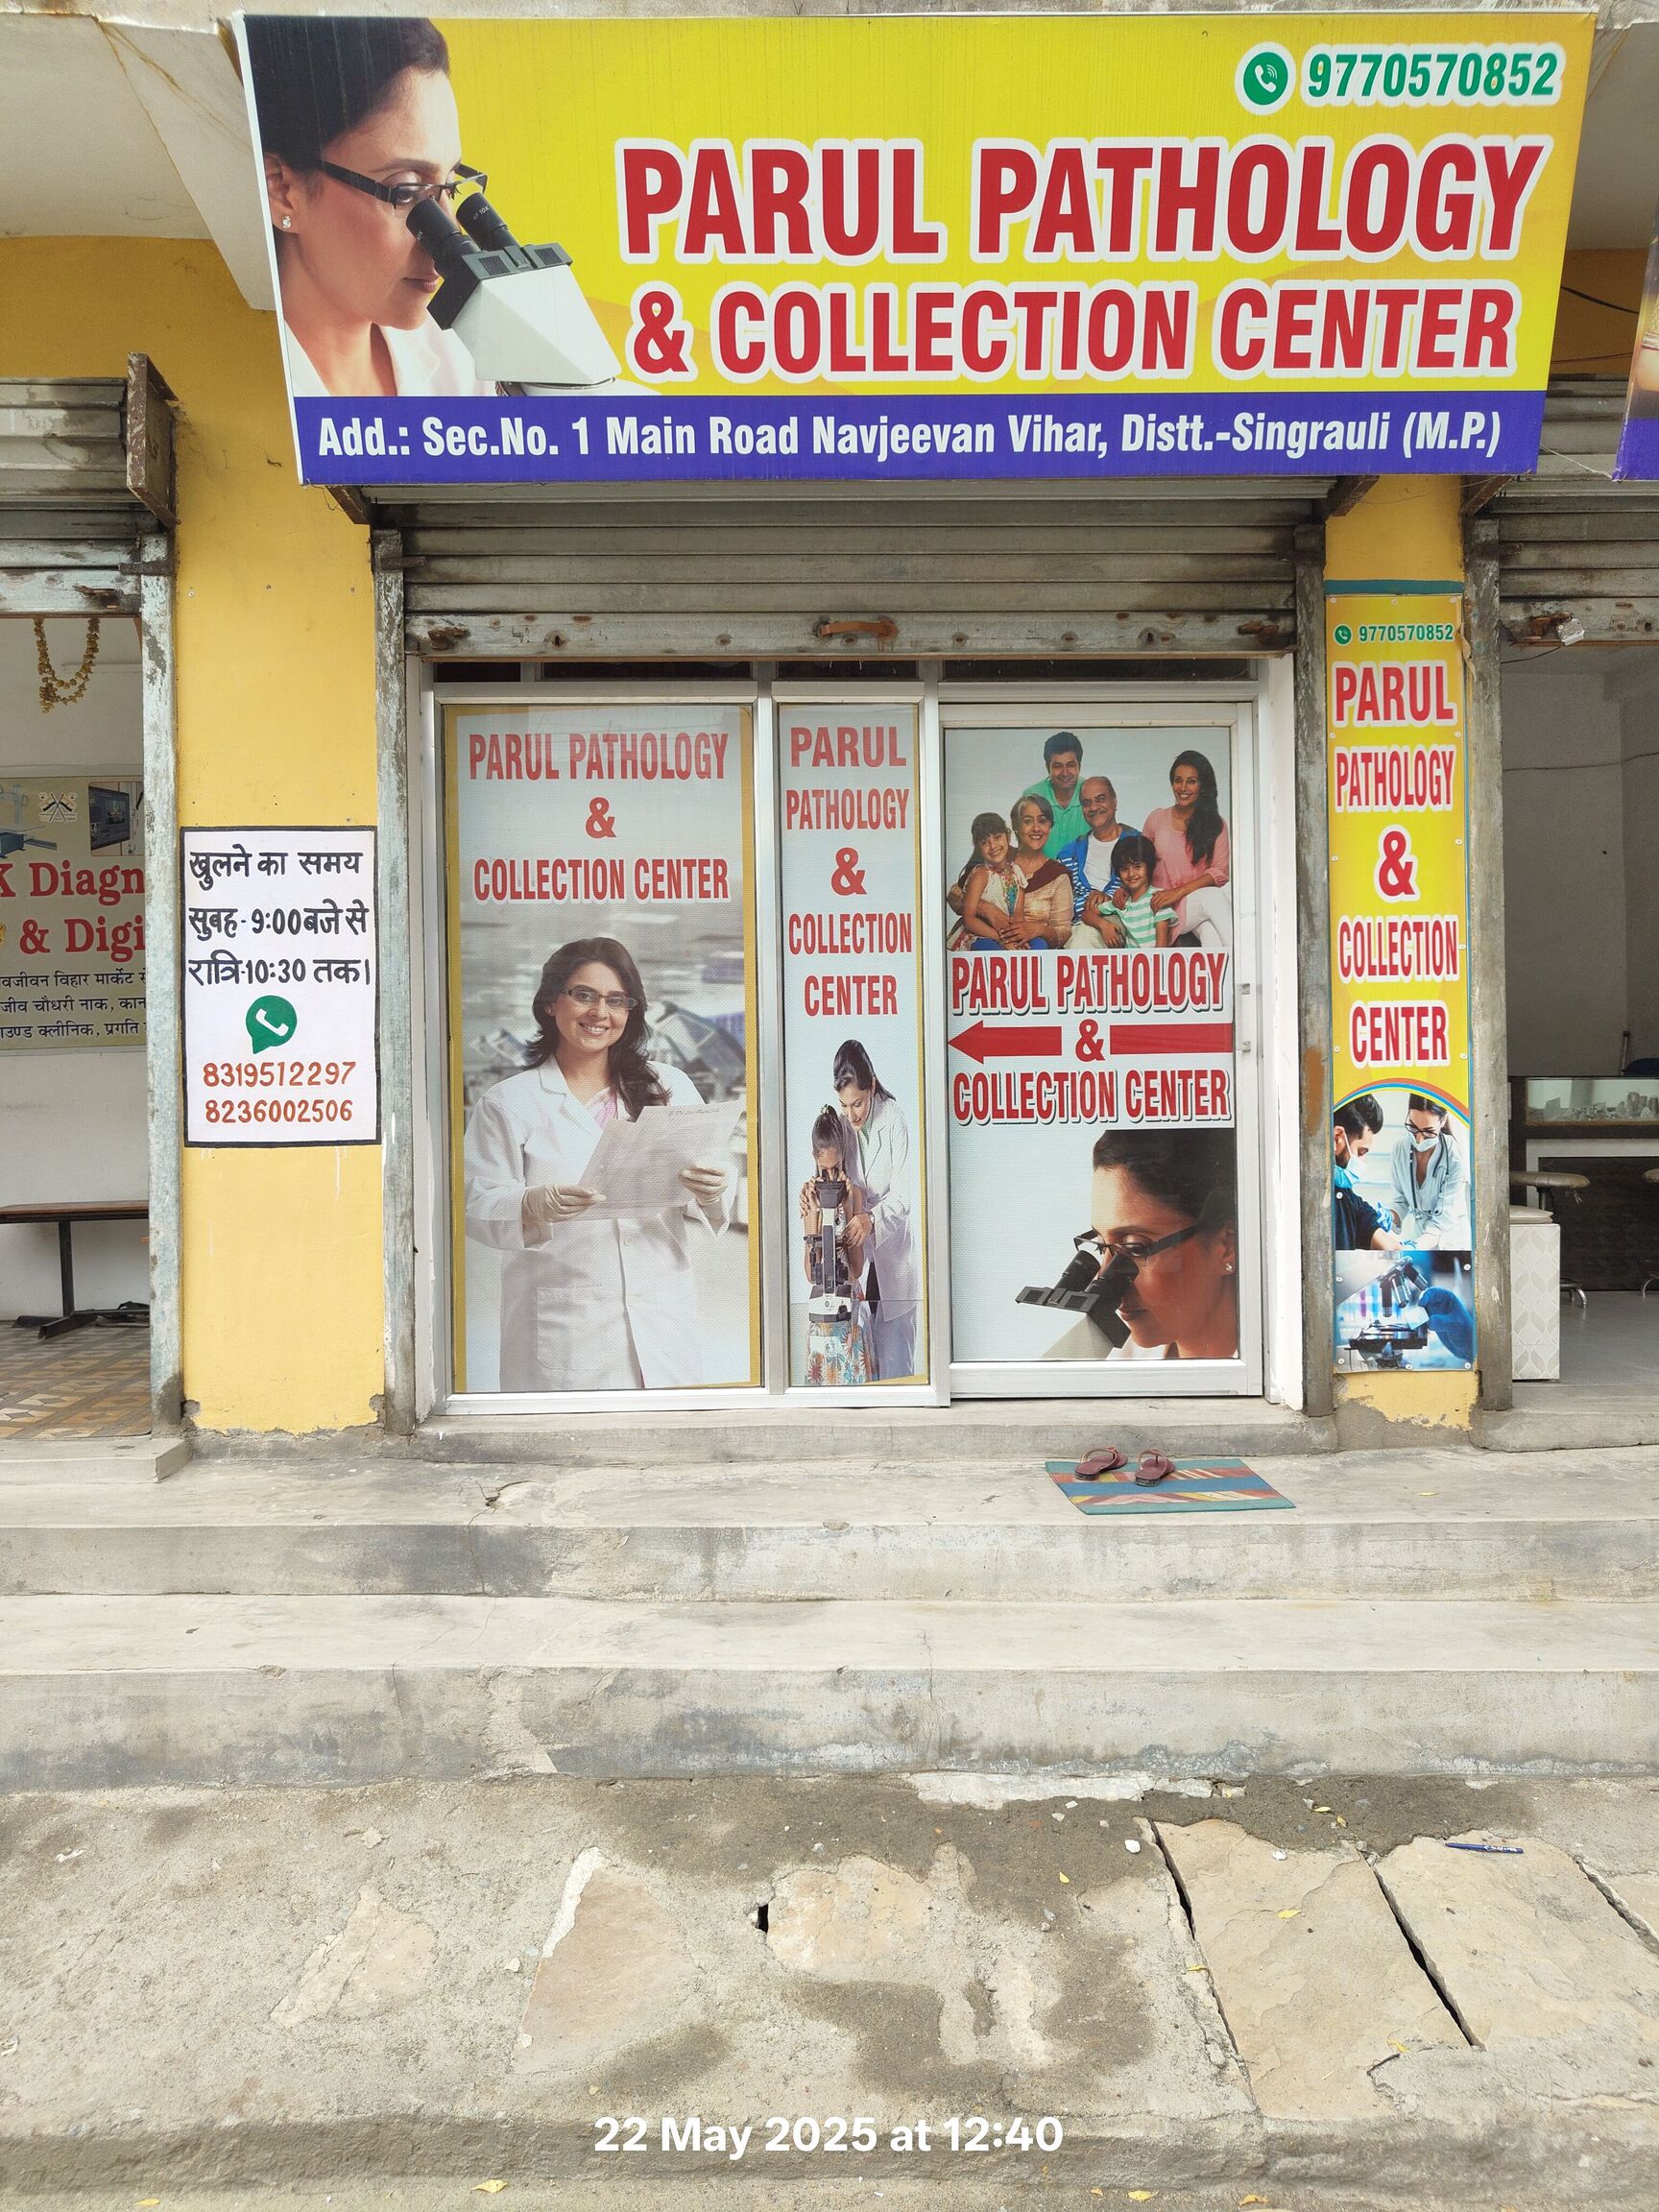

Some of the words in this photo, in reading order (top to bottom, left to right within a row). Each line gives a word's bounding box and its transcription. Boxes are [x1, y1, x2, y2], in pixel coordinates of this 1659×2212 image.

[1309, 53, 1557, 97] 9770570852
[624, 149, 939, 256] PARUL
[978, 144, 1543, 253] PATHOLOGY
[634, 291, 688, 373] &
[719, 289, 1190, 373] COLLECTION
[1220, 288, 1514, 371] CENTER
[320, 418, 409, 455] Add.:
[422, 417, 558, 455] Sec.No.
[572, 418, 588, 454] 1
[607, 417, 695, 454] Main
[710, 417, 798, 454] Road
[813, 416, 994, 462] Navjeevan
[1008, 415, 1107, 458] Vihar,
[1122, 413, 1390, 458] Distt.-Singrauli
[1404, 412, 1500, 458] (M.P.)
[1359, 624, 1453, 642] 9770570852
[1335, 665, 1454, 722] PARUL
[470, 735, 558, 780] PARUL
[570, 734, 727, 779] PATHOLOGY
[791, 728, 905, 766] PARUL
[1336, 750, 1454, 806] PATHOLOGY
[587, 798, 614, 838] &
[786, 789, 908, 830] PATHOLOGY
[189, 843, 252, 891] खुलने
[258, 853, 287, 876] का
[298, 853, 363, 875] समय
[474, 859, 624, 900] COLLECTION
[635, 858, 728, 900] CENTER
[831, 848, 865, 895] &
[1379, 830, 1414, 897] &
[19, 919, 51, 954] &
[789, 913, 912, 954] COLLECTION
[1339, 921, 1457, 977] COLLECTION
[0, 971, 49, 988] वजीवन
[54, 970, 89, 988] विहार
[94, 968, 134, 985] मार्केट
[805, 975, 897, 1016] CENTER
[952, 956, 1046, 1009] PARUL
[1057, 952, 1224, 1007] PATHOLOGY
[33, 995, 75, 1013] चौधरी
[1075, 1019, 1104, 1062] &
[1352, 1006, 1447, 1062] CENTER
[204, 1062, 354, 1087] 8319512297
[953, 1071, 1115, 1120] COLLECTION
[1125, 1070, 1227, 1118] CENTER
[206, 1099, 352, 1122] 8236002506
